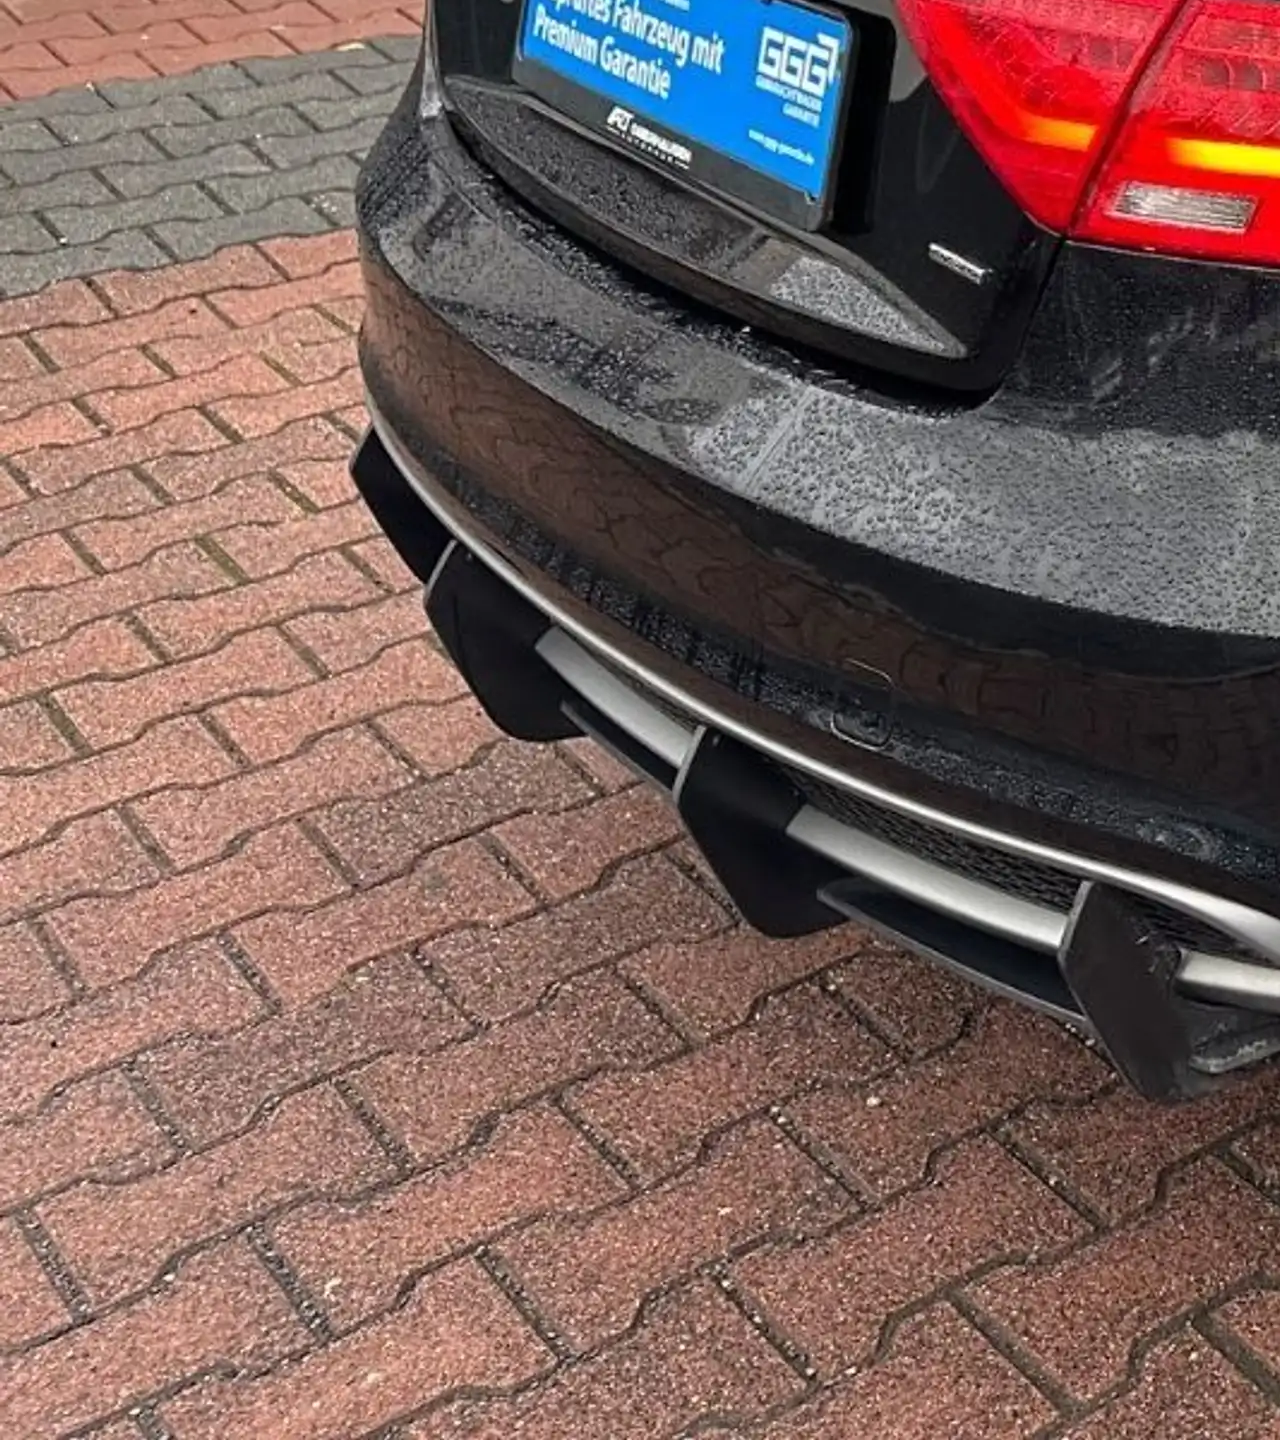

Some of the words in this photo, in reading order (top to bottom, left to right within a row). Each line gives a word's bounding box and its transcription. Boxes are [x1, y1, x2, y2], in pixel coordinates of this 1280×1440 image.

[532, 2, 599, 66] Premium
[599, 35, 671, 100] Garantie
[691, 31, 725, 75] mit
[757, 26, 829, 98] GGG
